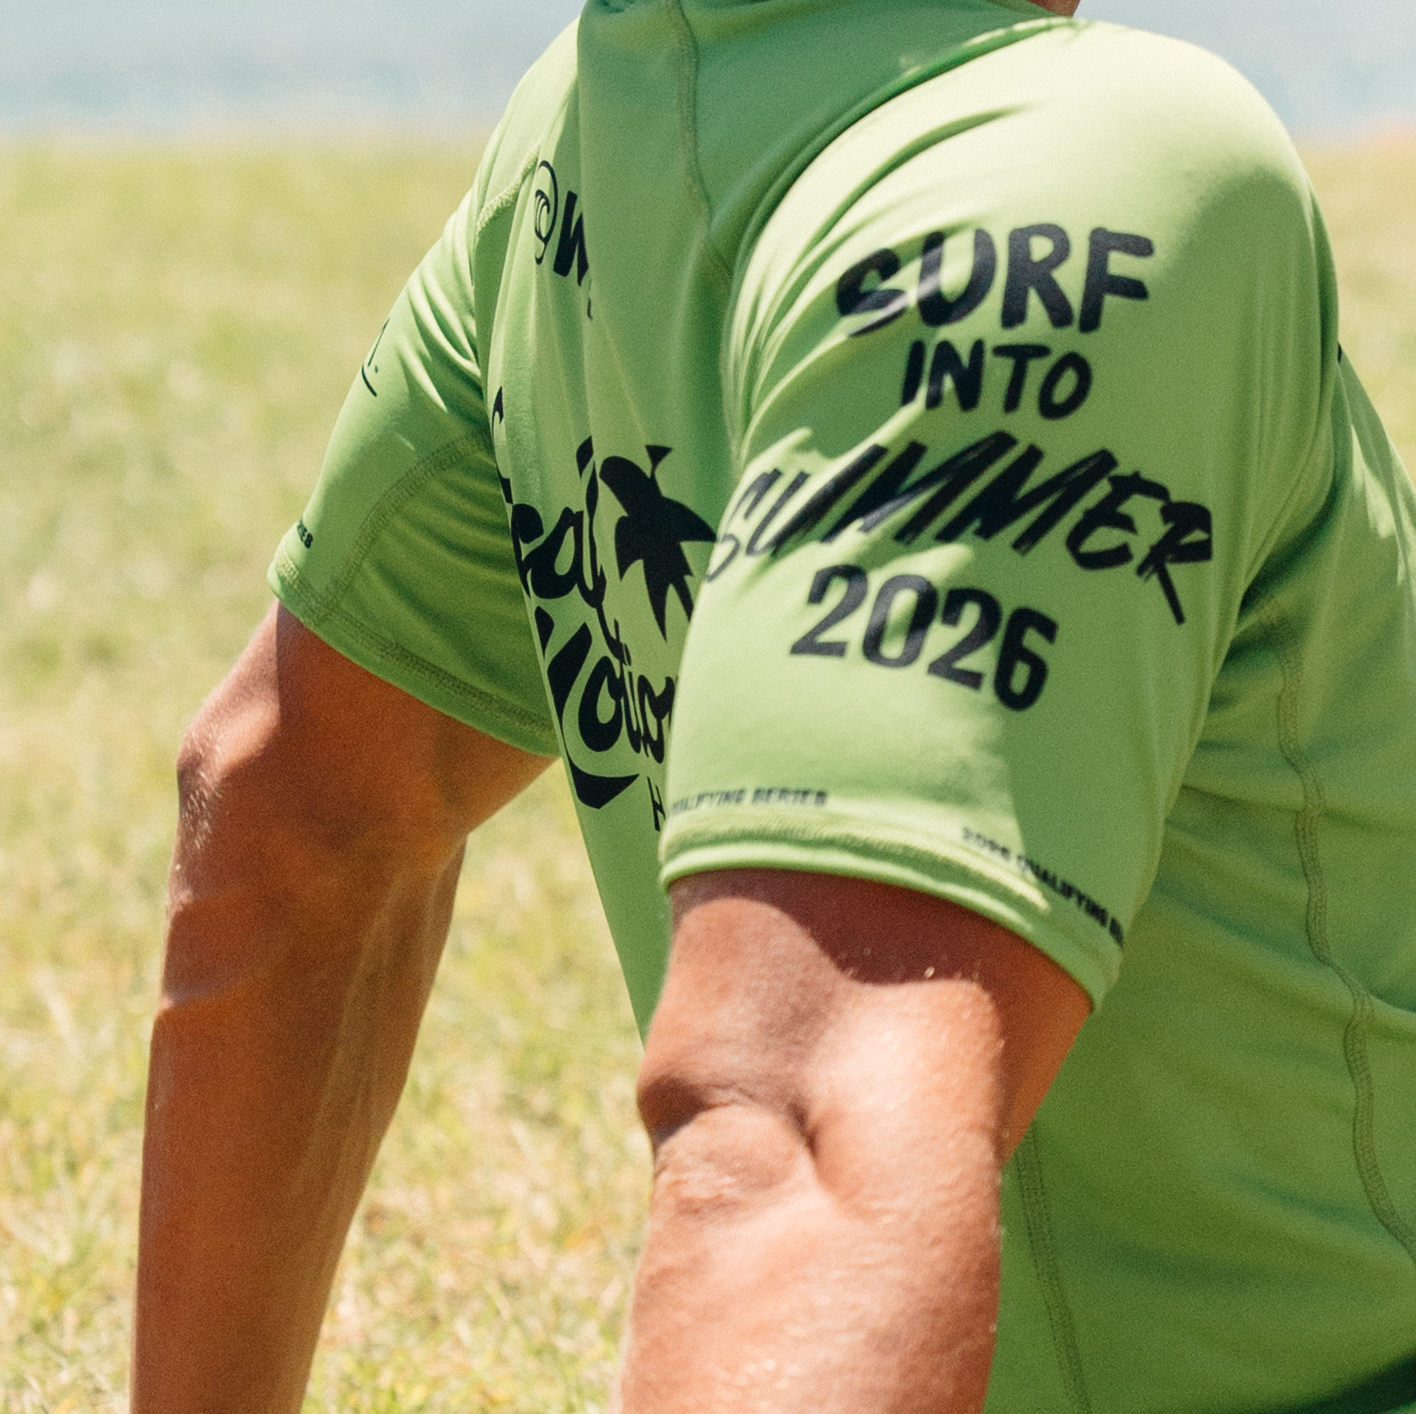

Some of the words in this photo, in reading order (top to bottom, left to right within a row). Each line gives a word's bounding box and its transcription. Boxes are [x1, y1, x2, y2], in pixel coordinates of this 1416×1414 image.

[835, 223, 1155, 338] SURF
[900, 338, 1092, 420] INTO
[703, 430, 1213, 626] SUMMER
[789, 564, 1059, 712] 2026
